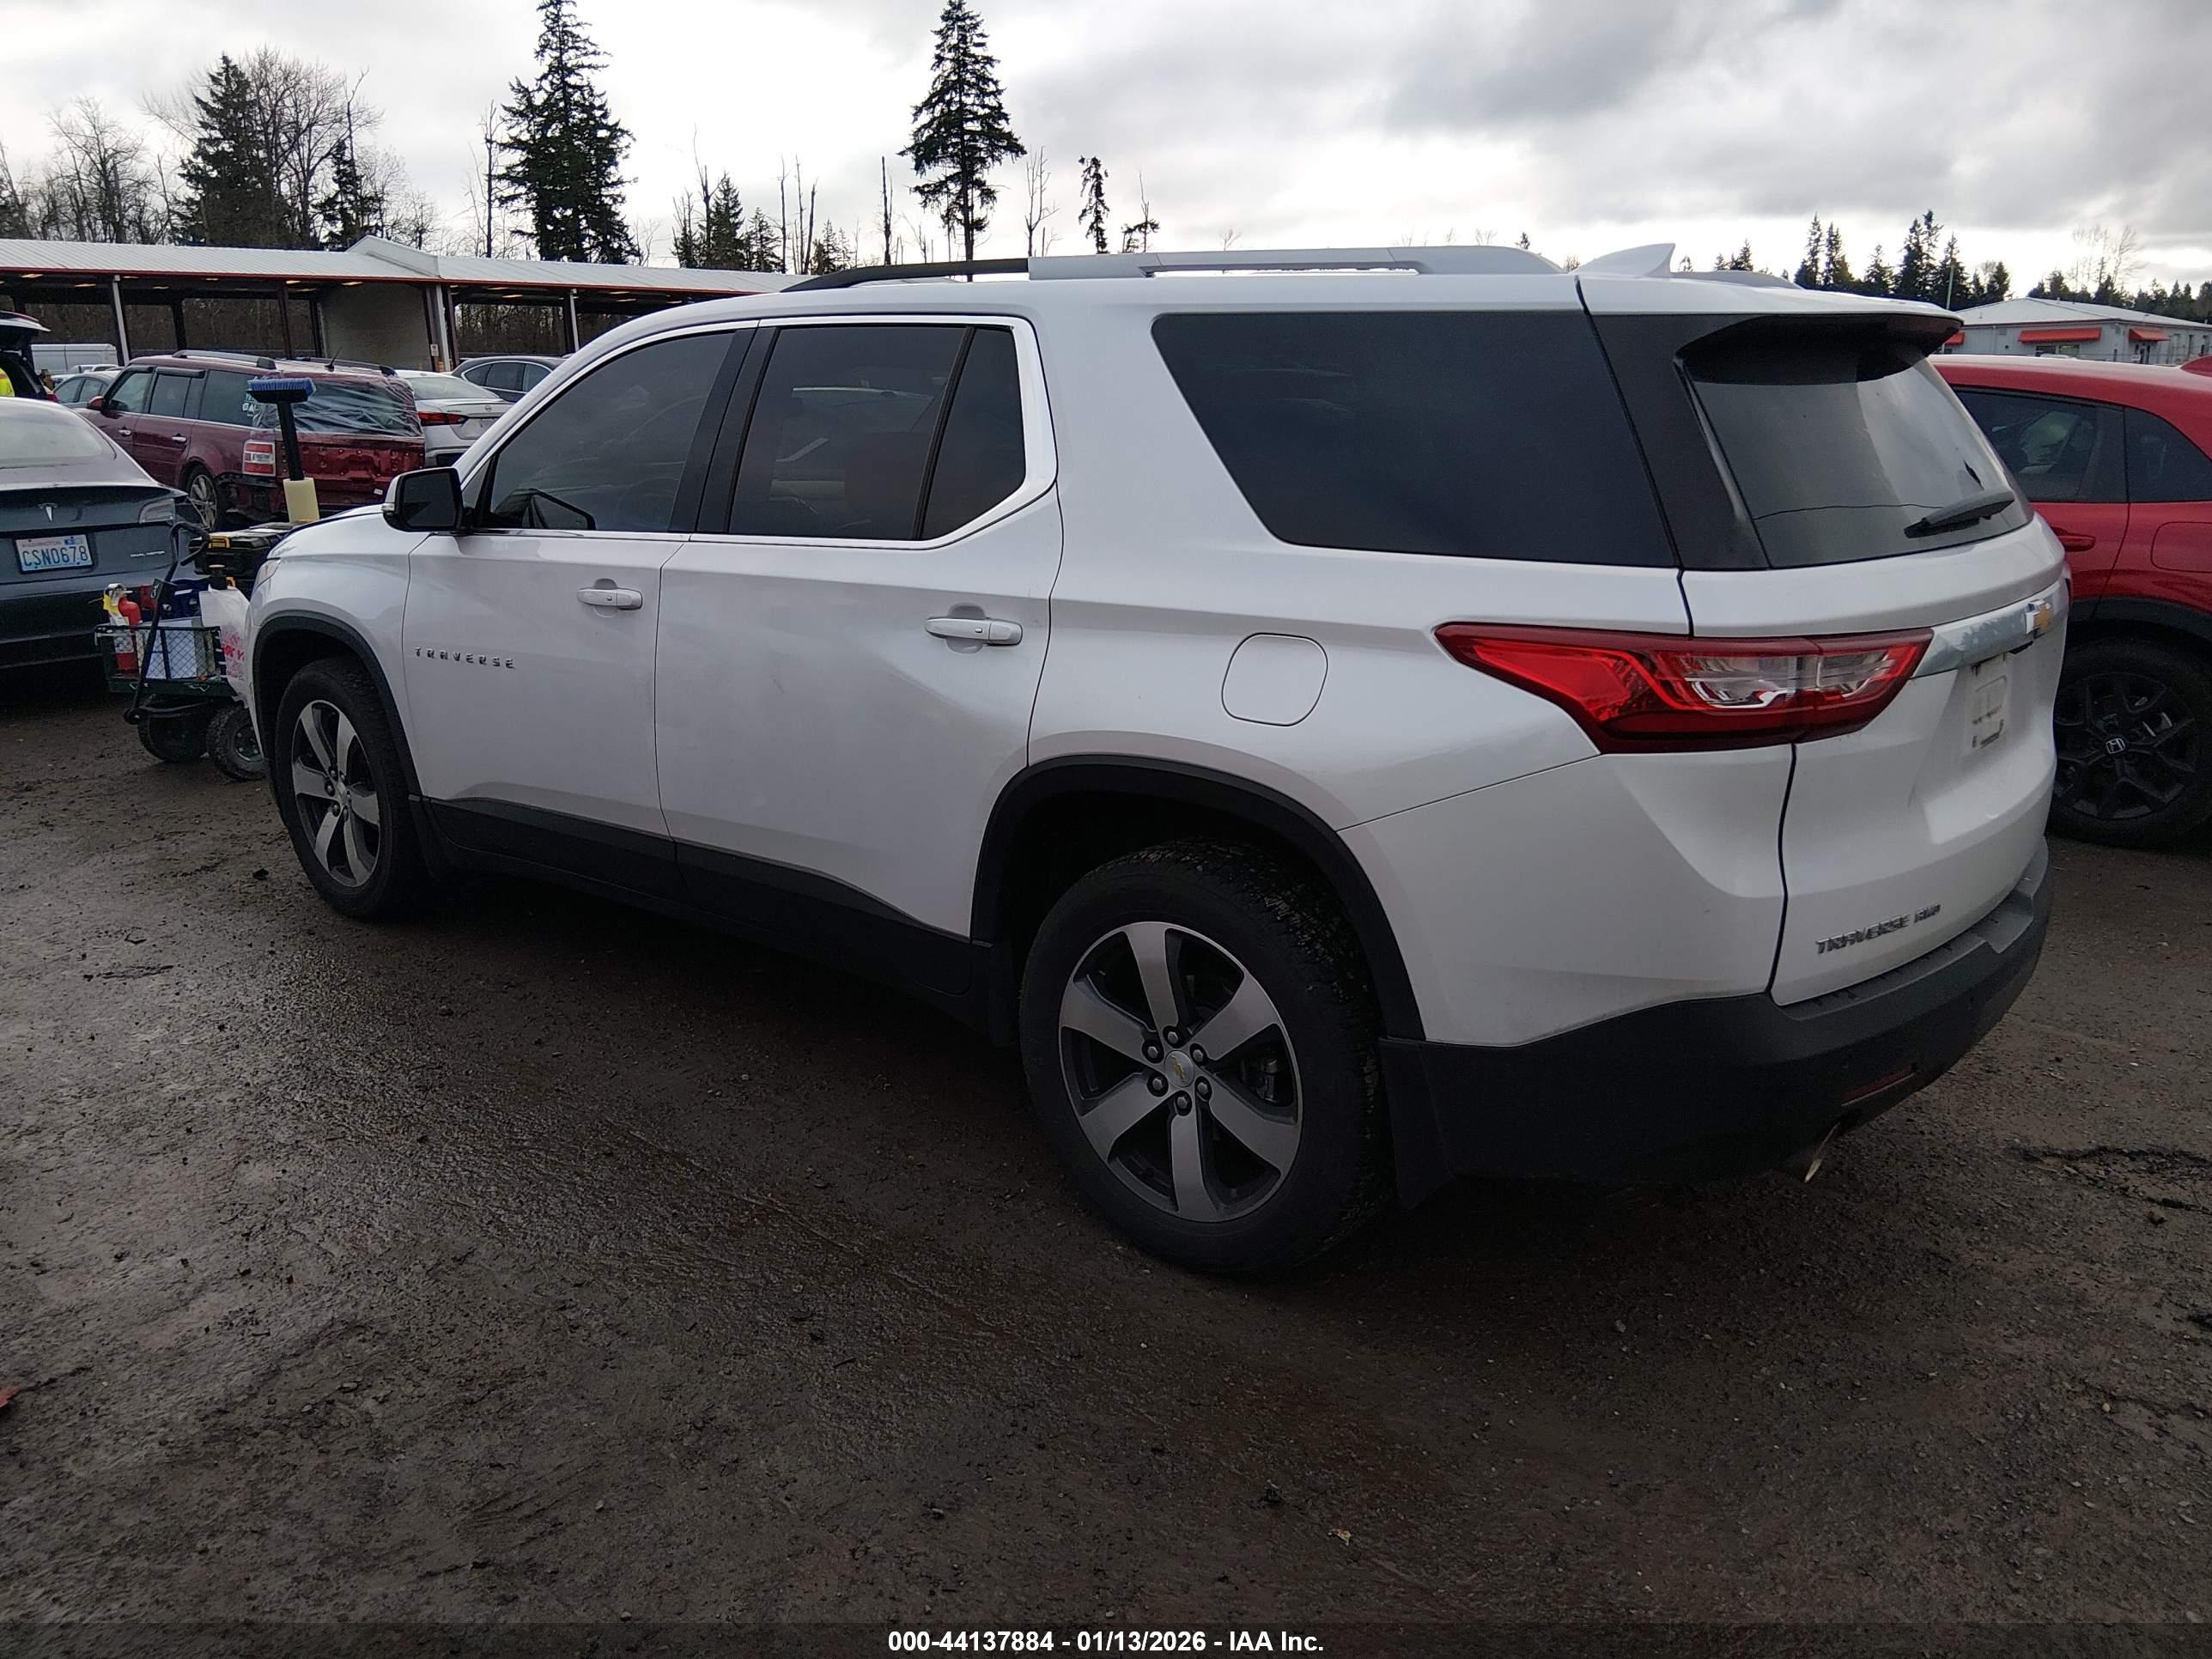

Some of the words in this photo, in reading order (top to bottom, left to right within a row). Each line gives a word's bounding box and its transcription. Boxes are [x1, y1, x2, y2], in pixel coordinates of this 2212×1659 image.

[22, 545, 89, 567] CSN0678
[414, 647, 515, 670] TRAVERSE
[1815, 913, 1911, 954] TRAVERSE
